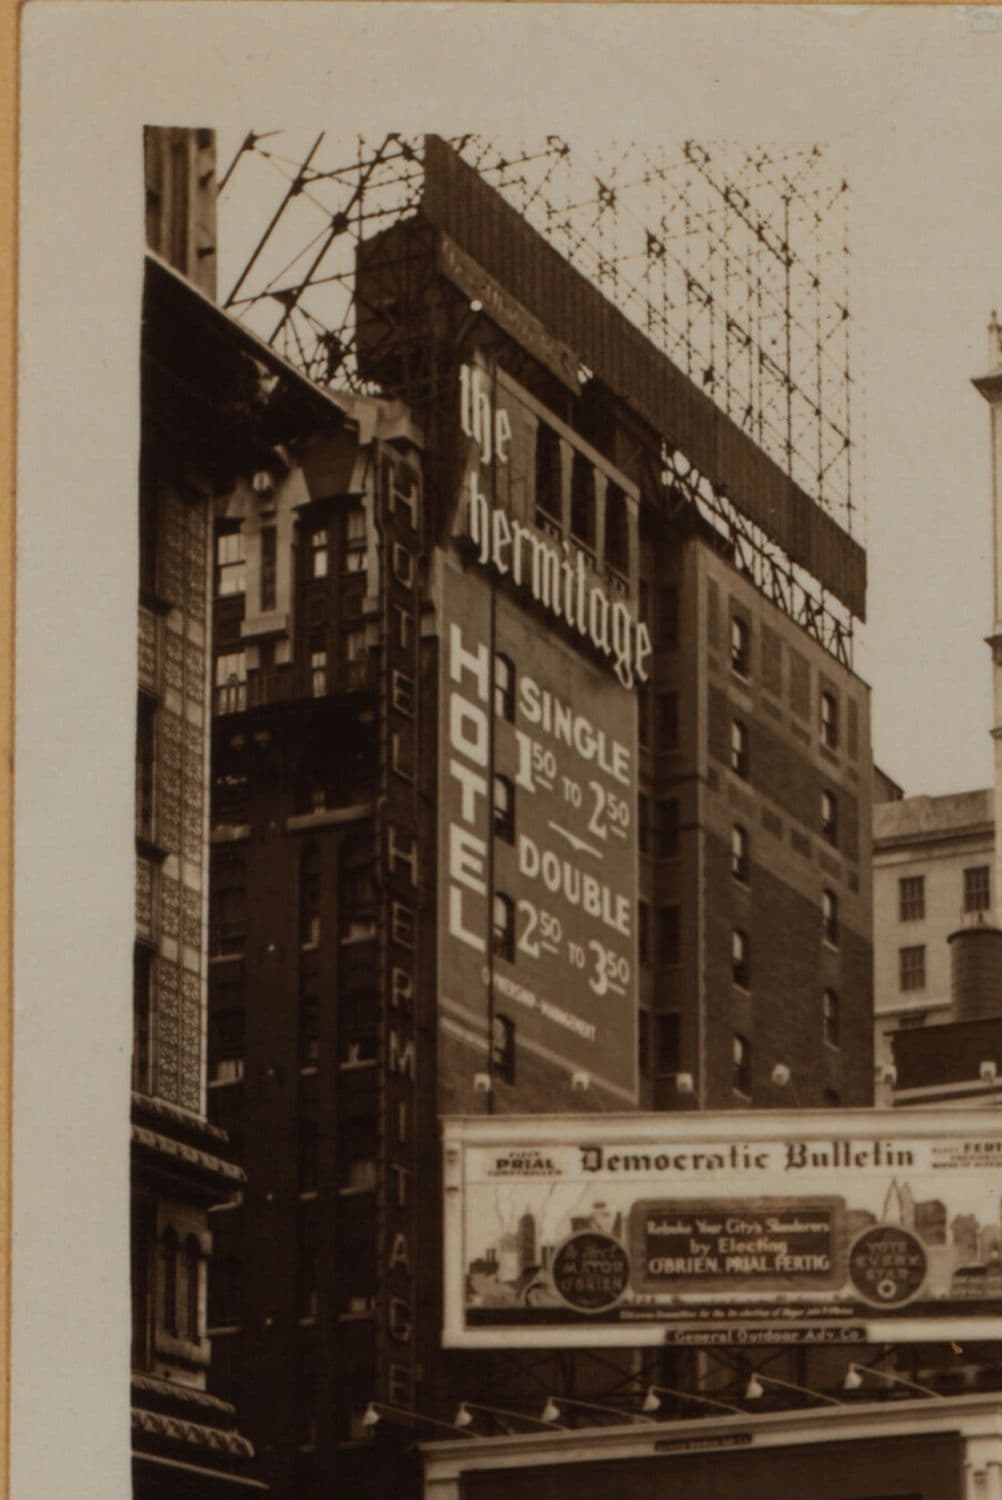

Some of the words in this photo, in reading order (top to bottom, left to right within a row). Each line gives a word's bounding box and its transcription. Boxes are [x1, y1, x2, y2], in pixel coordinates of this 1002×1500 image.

[460, 363, 512, 464] the
[469, 470, 653, 690] hermitage
[519, 675, 630, 786] SINGLE
[449, 622, 488, 952] HOTEL
[562, 775, 582, 807] TO
[519, 835, 630, 936] DOUBLE
[567, 941, 585, 969] TO
[495, 1158, 555, 1169] PRIAL
[578, 1143, 769, 1173] Democratic
[785, 1141, 914, 1171] Bulletin
[690, 1238, 710, 1256] by
[718, 1235, 788, 1255] Electing
[671, 1327, 732, 1344] General
[737, 1327, 800, 1343] Outdoor
